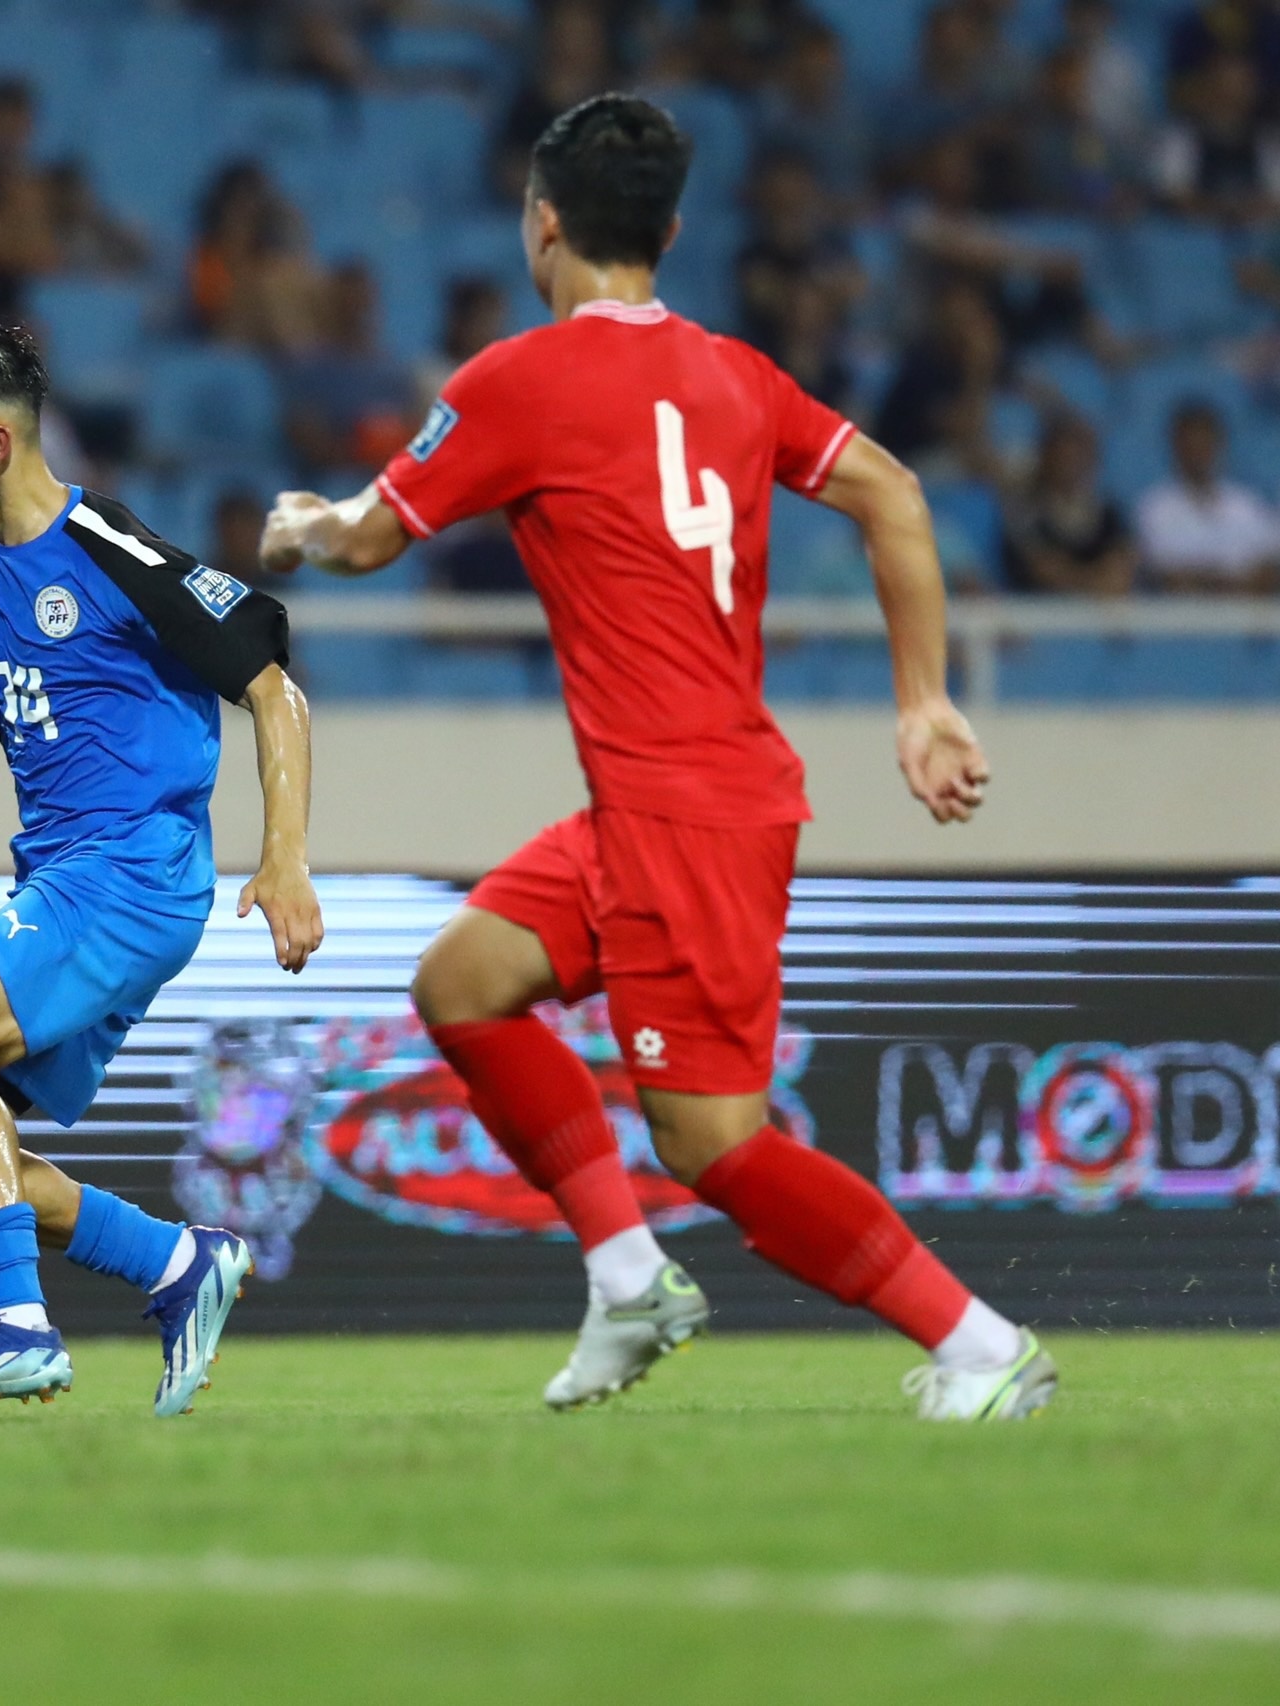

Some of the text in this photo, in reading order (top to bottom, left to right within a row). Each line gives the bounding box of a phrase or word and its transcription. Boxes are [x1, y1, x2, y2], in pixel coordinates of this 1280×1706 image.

[655, 400, 734, 615] 4
[48, 614, 69, 625] PFF
[878, 1040, 1280, 1211] MOD
